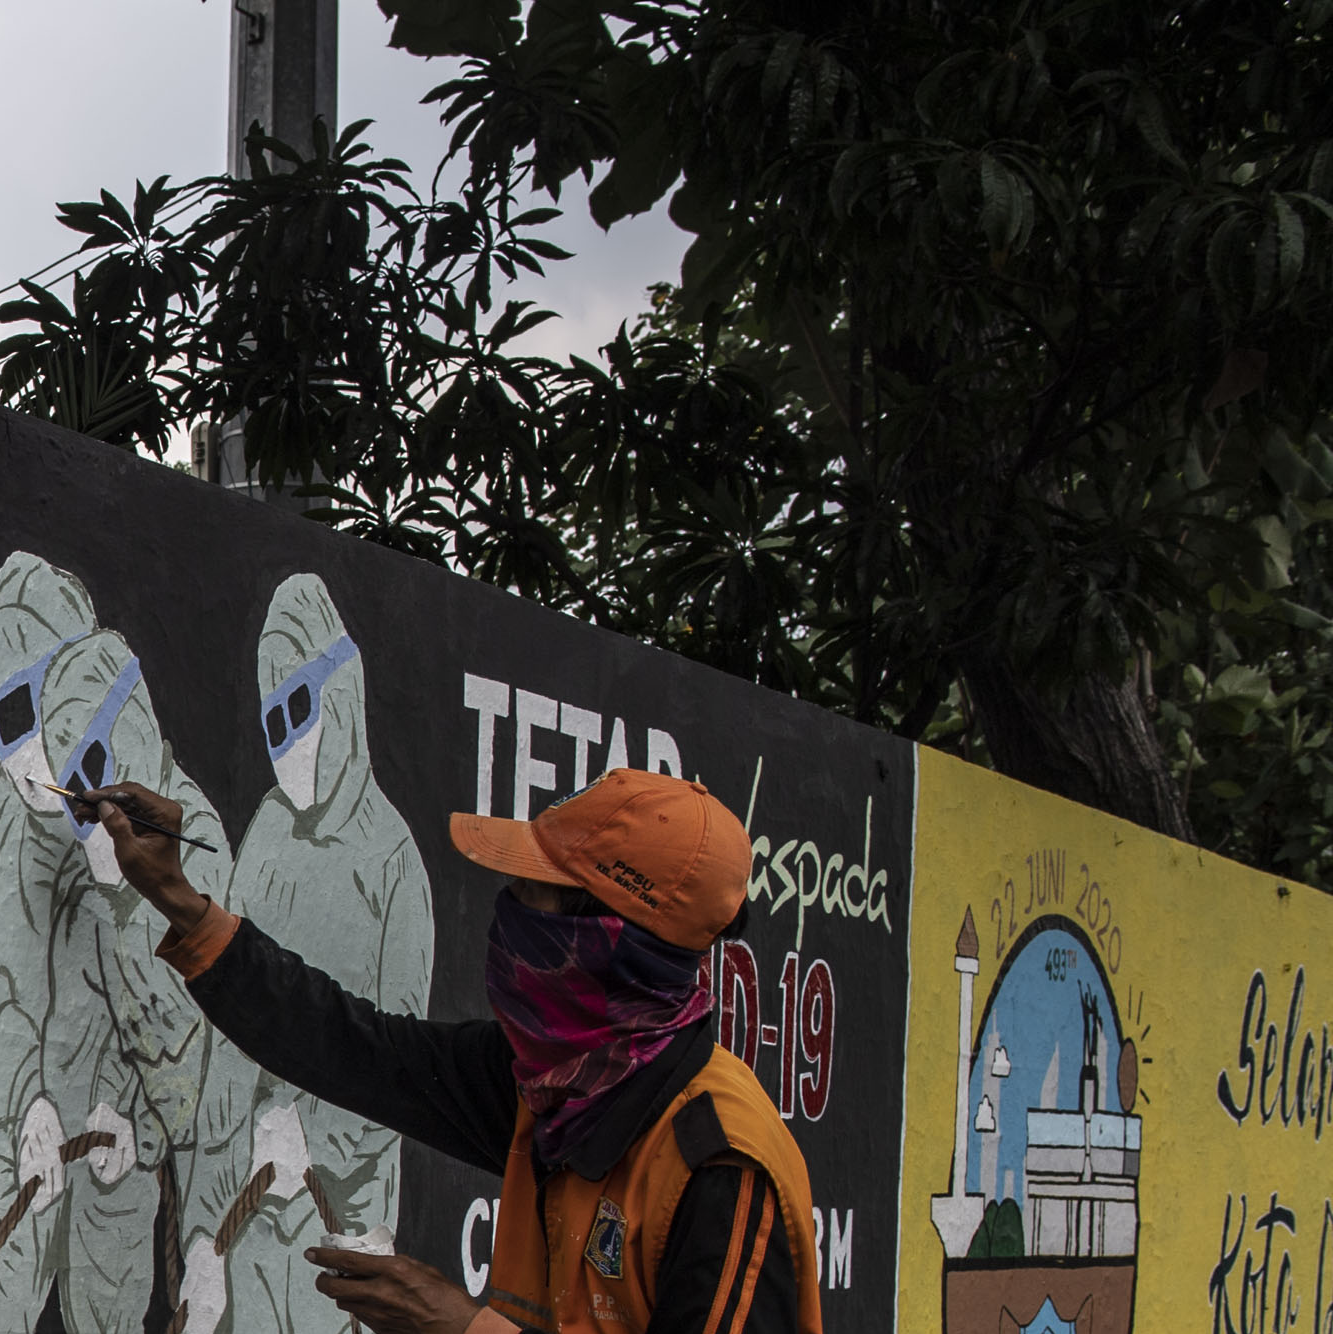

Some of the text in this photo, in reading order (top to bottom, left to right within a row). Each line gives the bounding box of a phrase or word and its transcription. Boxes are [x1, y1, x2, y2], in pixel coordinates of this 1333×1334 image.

[612, 859, 655, 892] PPSU
[991, 848, 1122, 975] 22 JUNI 2020
